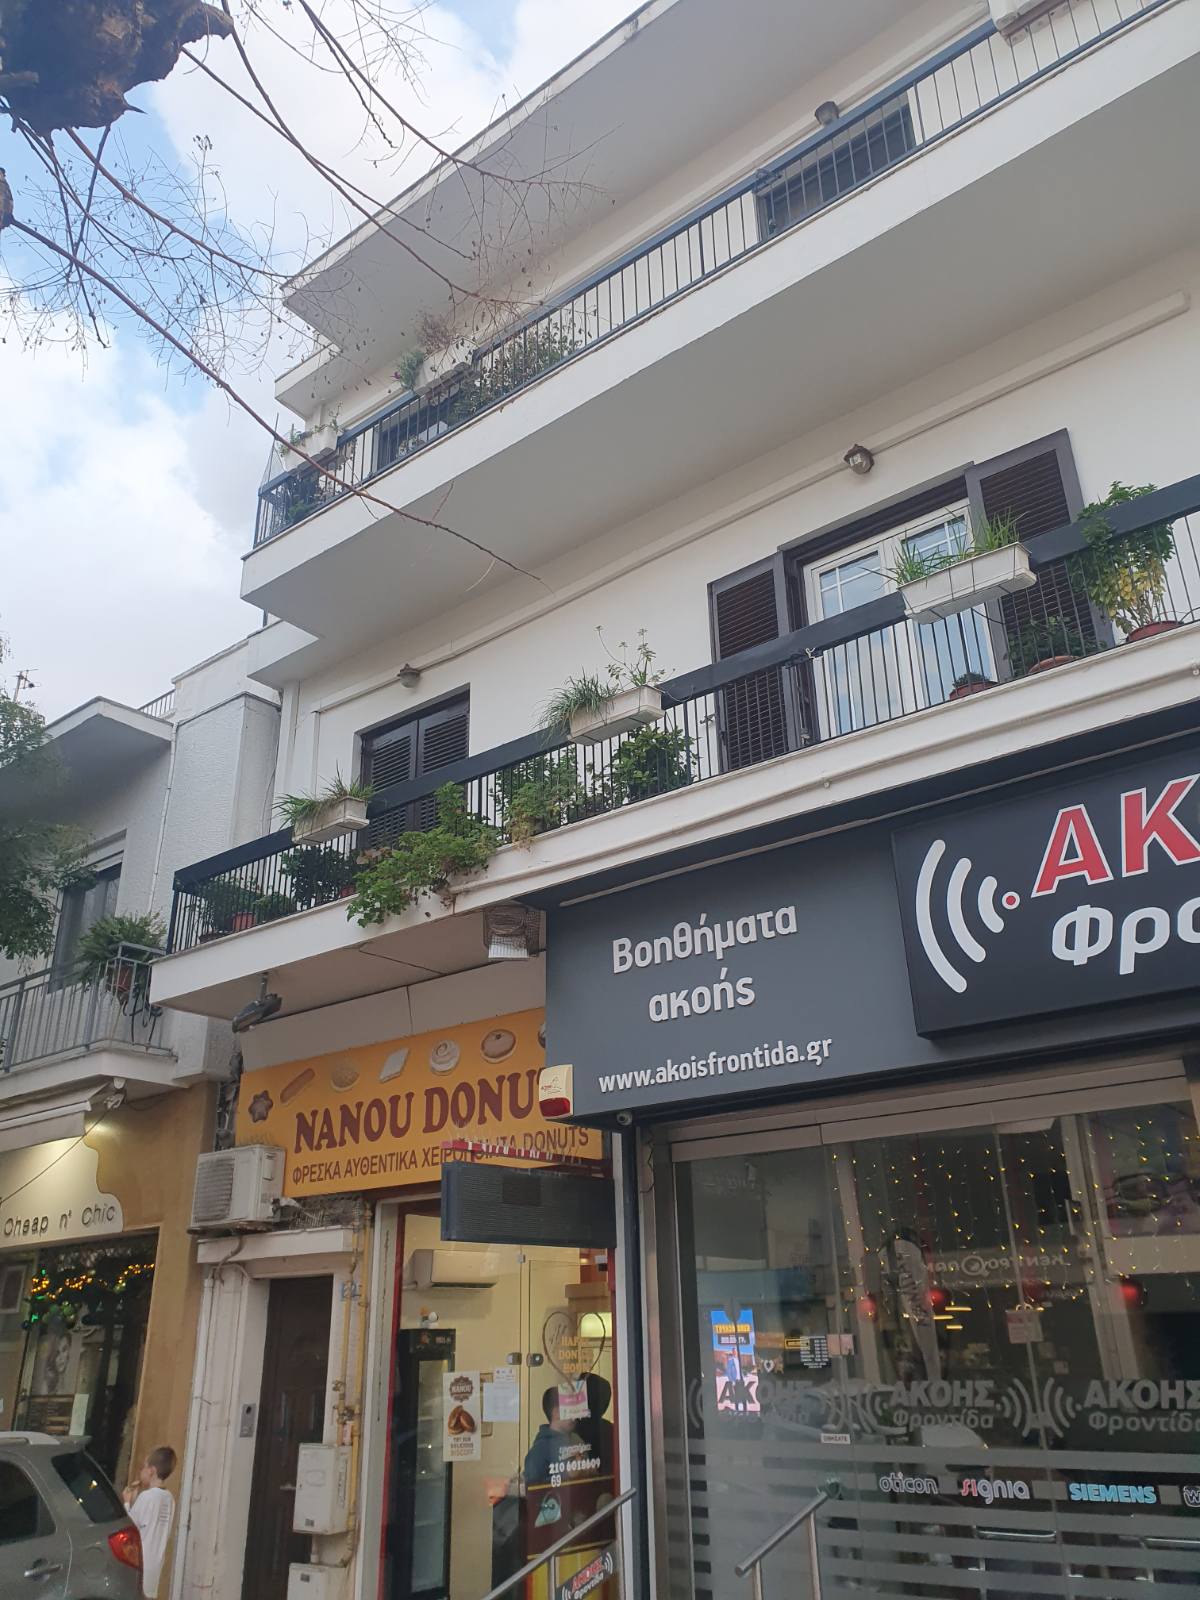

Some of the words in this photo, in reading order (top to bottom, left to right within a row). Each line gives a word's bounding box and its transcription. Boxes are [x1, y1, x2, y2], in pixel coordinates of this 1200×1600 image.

[1031, 772, 1200, 898] ΑΚ
[612, 905, 798, 974] Βοηθήματα
[648, 967, 756, 1022] ακοής
[598, 1038, 833, 1093] www.akoisfrontida.gr
[293, 1092, 415, 1154] NANOU
[422, 1068, 542, 1134] DONU
[292, 1159, 340, 1185] ΦΡΕΣΚΑ
[343, 1148, 418, 1179] ΑΥΘΕΝΤΙΚΑ
[523, 1126, 590, 1151] DONUTS
[3, 1215, 49, 1237] Cheap
[81, 1202, 116, 1226] Chic
[889, 1380, 994, 1408] ΑΚΟΗΣ
[879, 1472, 939, 1495] oticon
[961, 1478, 1031, 1505] signia
[1068, 1482, 1158, 1504] SIEMENS
